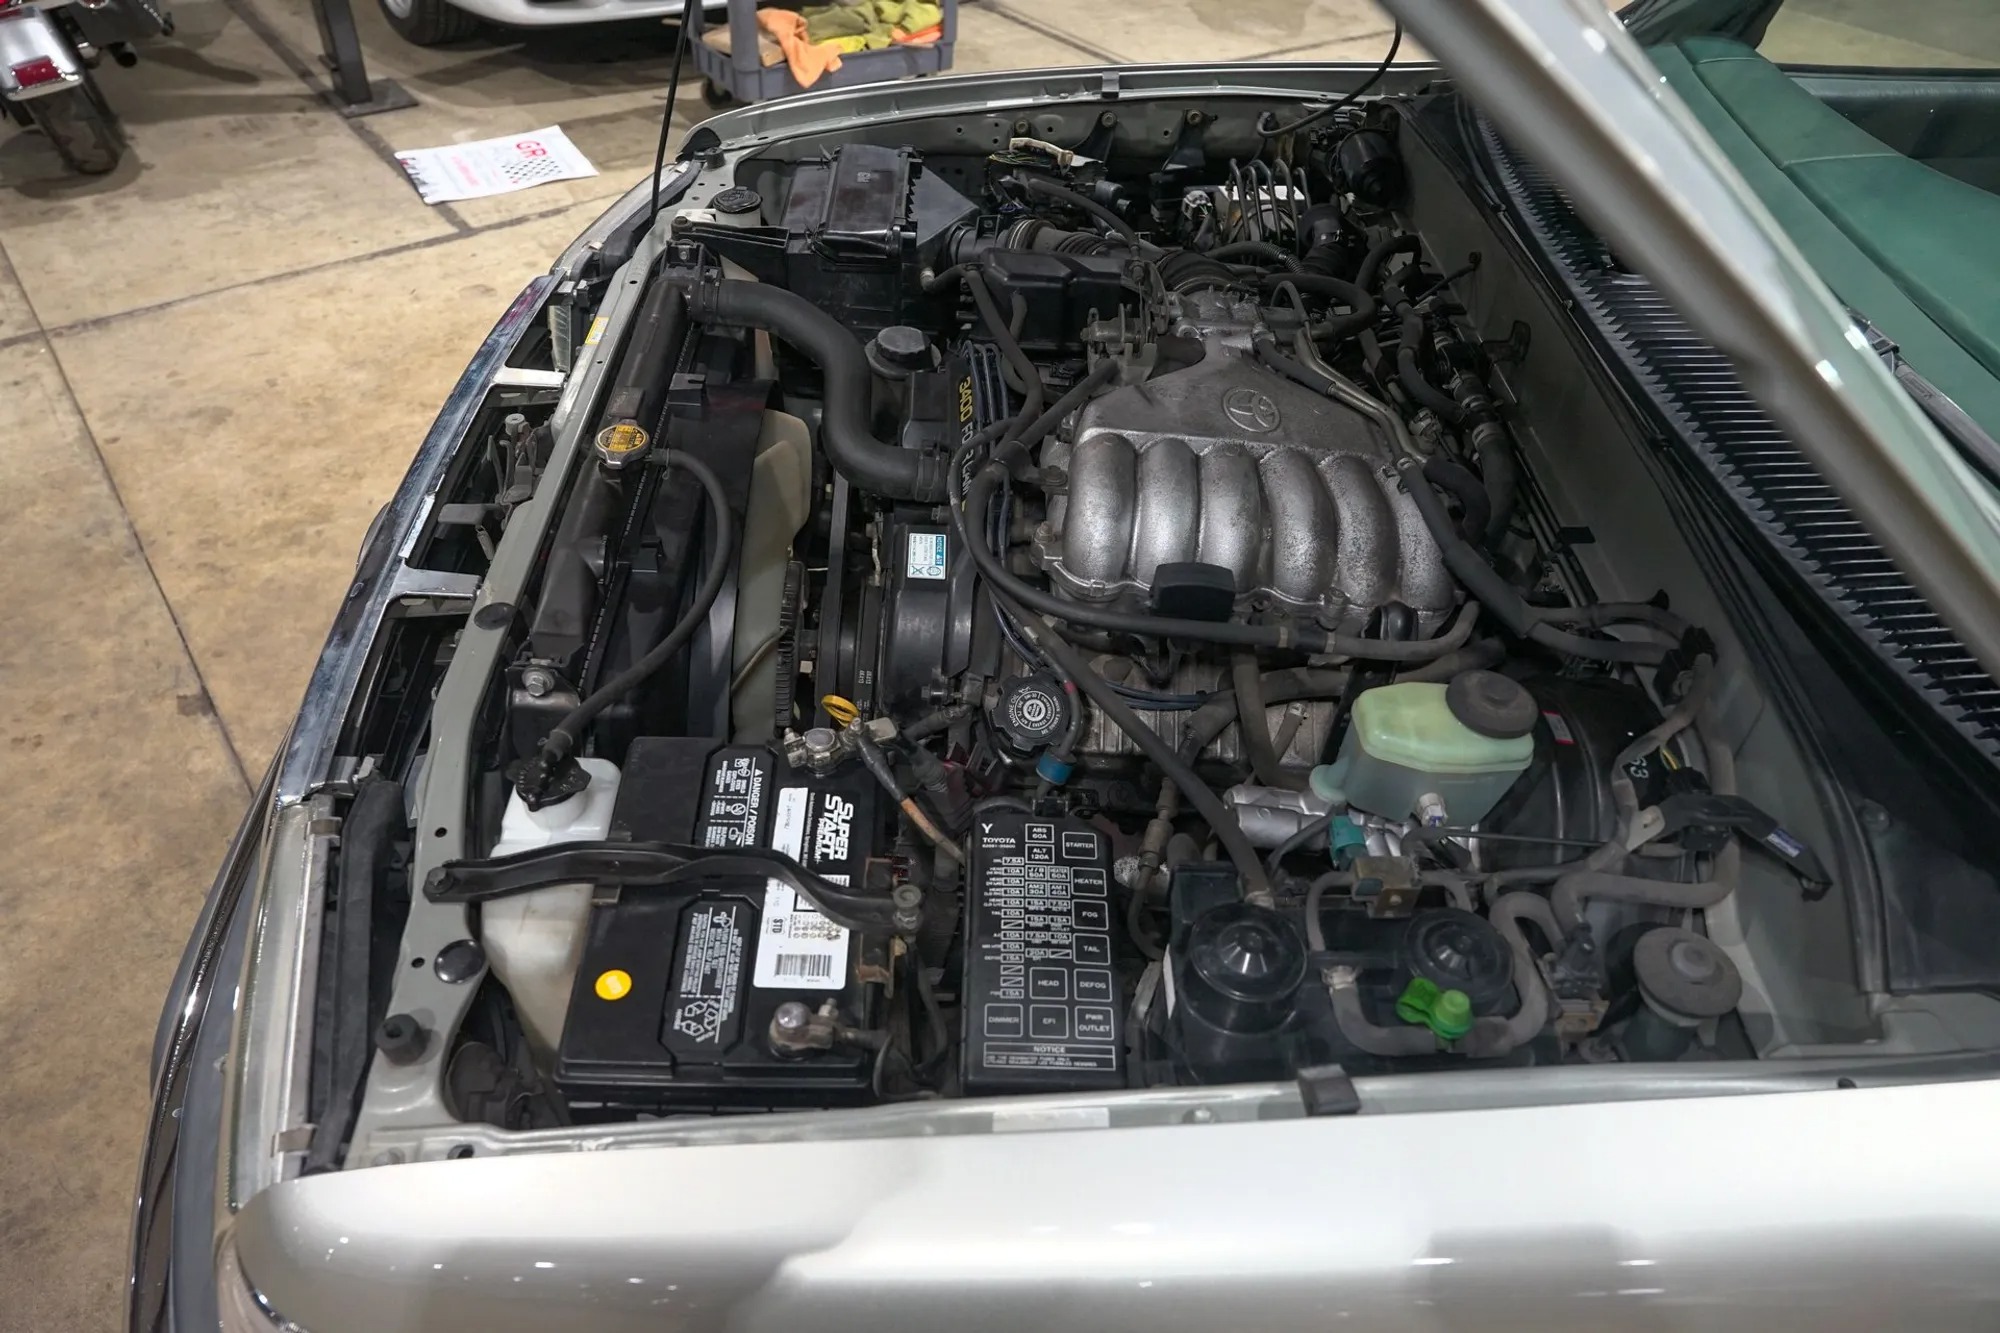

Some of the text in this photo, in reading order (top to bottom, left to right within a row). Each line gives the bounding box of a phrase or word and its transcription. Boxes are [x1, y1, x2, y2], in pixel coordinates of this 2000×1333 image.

[516, 140, 547, 158] GR
[958, 376, 972, 422] 3400
[1008, 694, 1020, 727] ENGINE OIL
[750, 777, 762, 808] DANGER
[744, 816, 758, 846] POISON
[824, 794, 842, 860] START
[834, 802, 854, 860] SUPER
[982, 823, 993, 834] Y
[772, 918, 784, 934] STD
